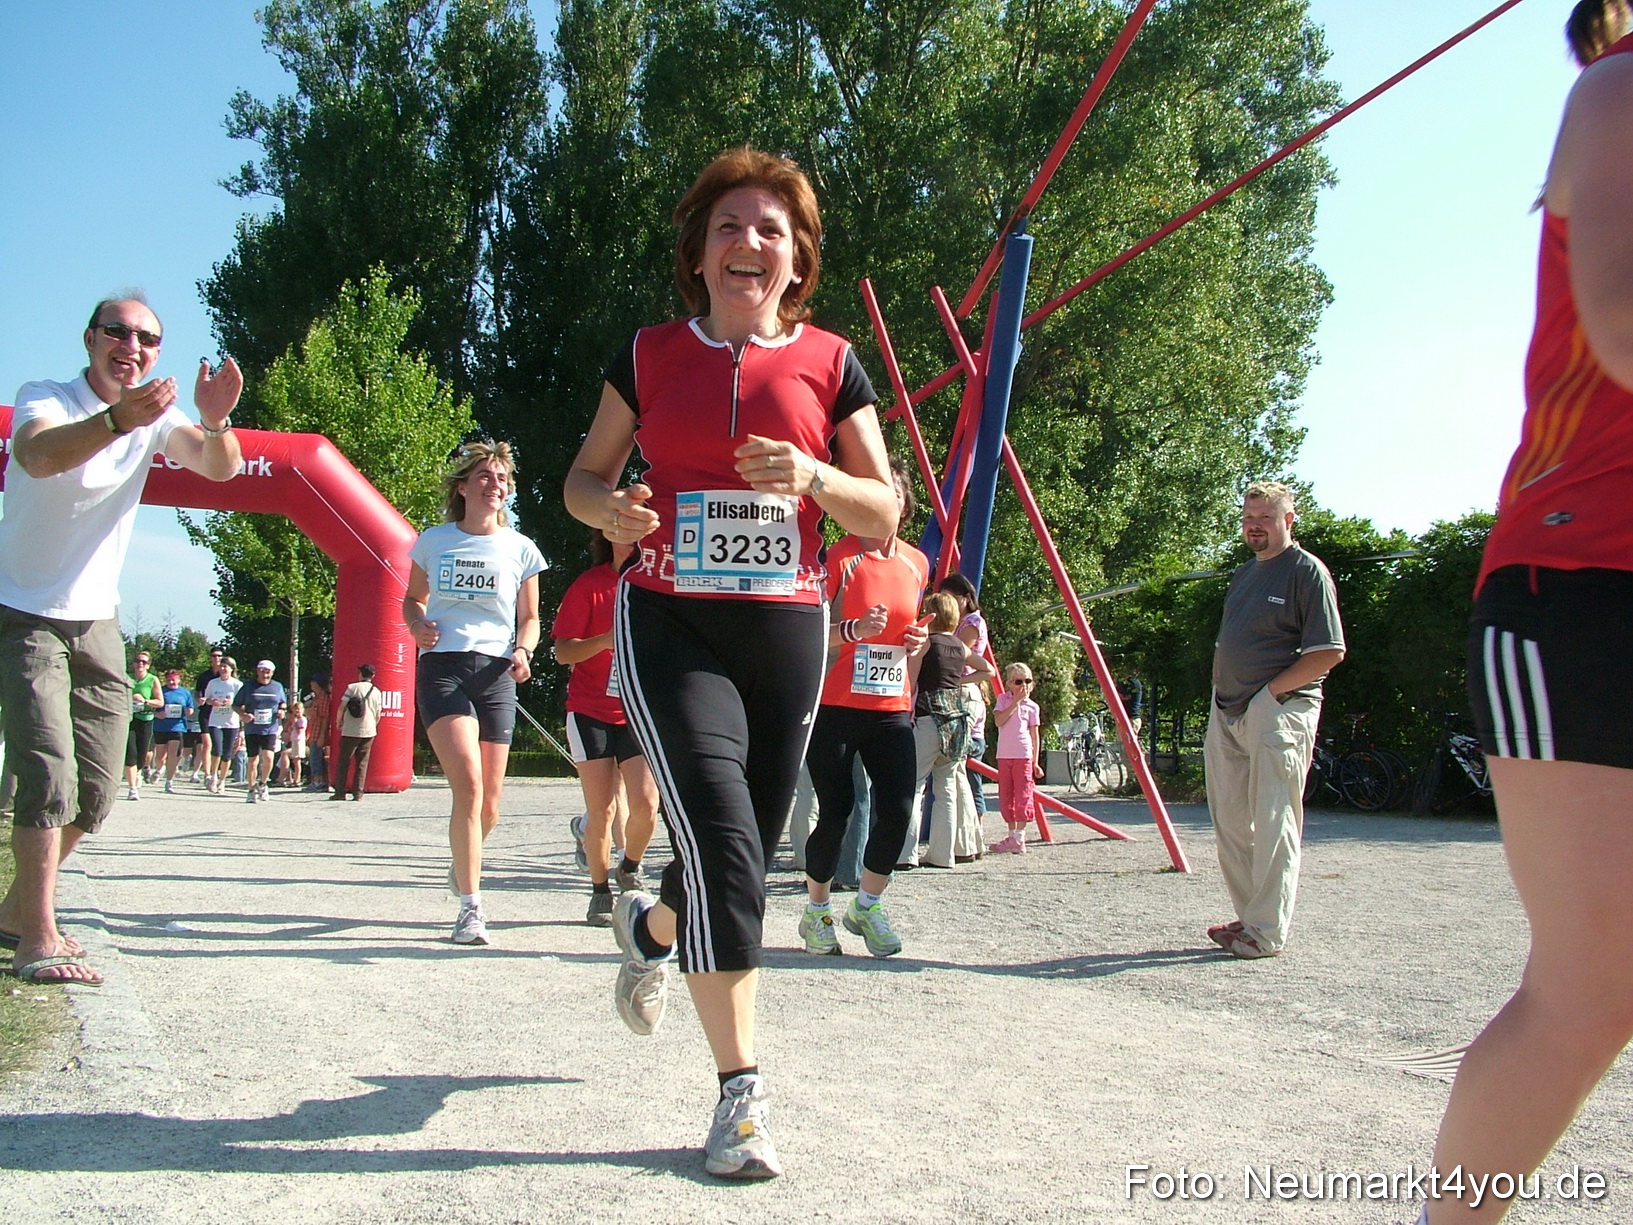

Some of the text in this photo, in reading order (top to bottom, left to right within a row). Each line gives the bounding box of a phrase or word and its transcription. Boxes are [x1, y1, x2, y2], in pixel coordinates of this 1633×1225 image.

[707, 501, 785, 523] Elisabeth
[683, 530, 696, 543] D
[709, 534, 792, 566] 3233
[455, 559, 486, 568] Renate
[454, 573, 496, 590] 2404
[869, 649, 893, 660] Ingrid
[858, 662, 864, 671] D
[869, 666, 903, 682] 2768
